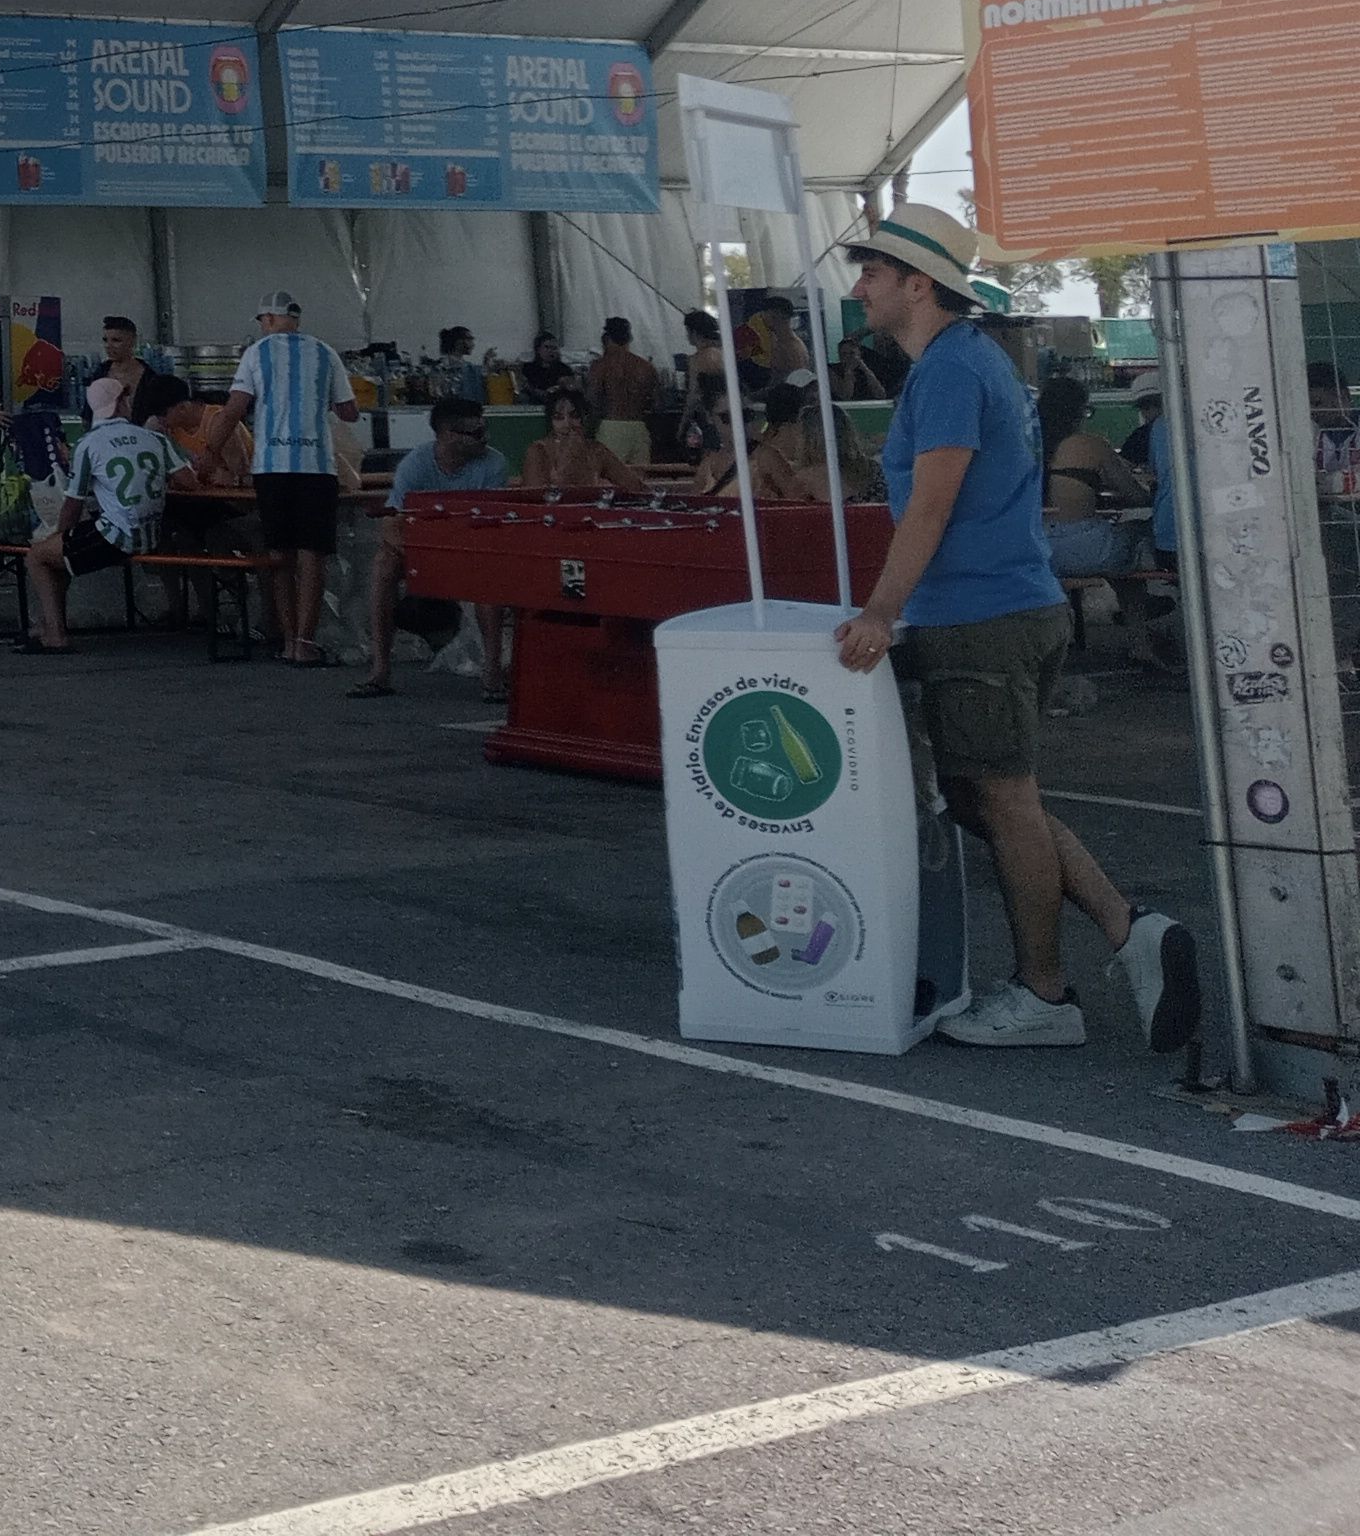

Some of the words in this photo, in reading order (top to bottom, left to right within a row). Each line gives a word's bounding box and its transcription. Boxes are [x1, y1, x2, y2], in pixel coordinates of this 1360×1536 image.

[90, 39, 189, 77] ARENAL
[506, 56, 590, 90] ARENAL
[92, 78, 192, 114] SOUND
[508, 92, 594, 125] SOUND
[95, 144, 162, 164] PULSERA
[163, 145, 175, 164] Y
[13, 302, 37, 317] Red
[106, 451, 162, 507] 22
[735, 676, 758, 691] de
[762, 673, 809, 696] vidre
[686, 686, 735, 743] Envasos
[714, 799, 736, 818] de
[738, 815, 815, 834] Envases
[874, 1195, 1172, 1273] 110
